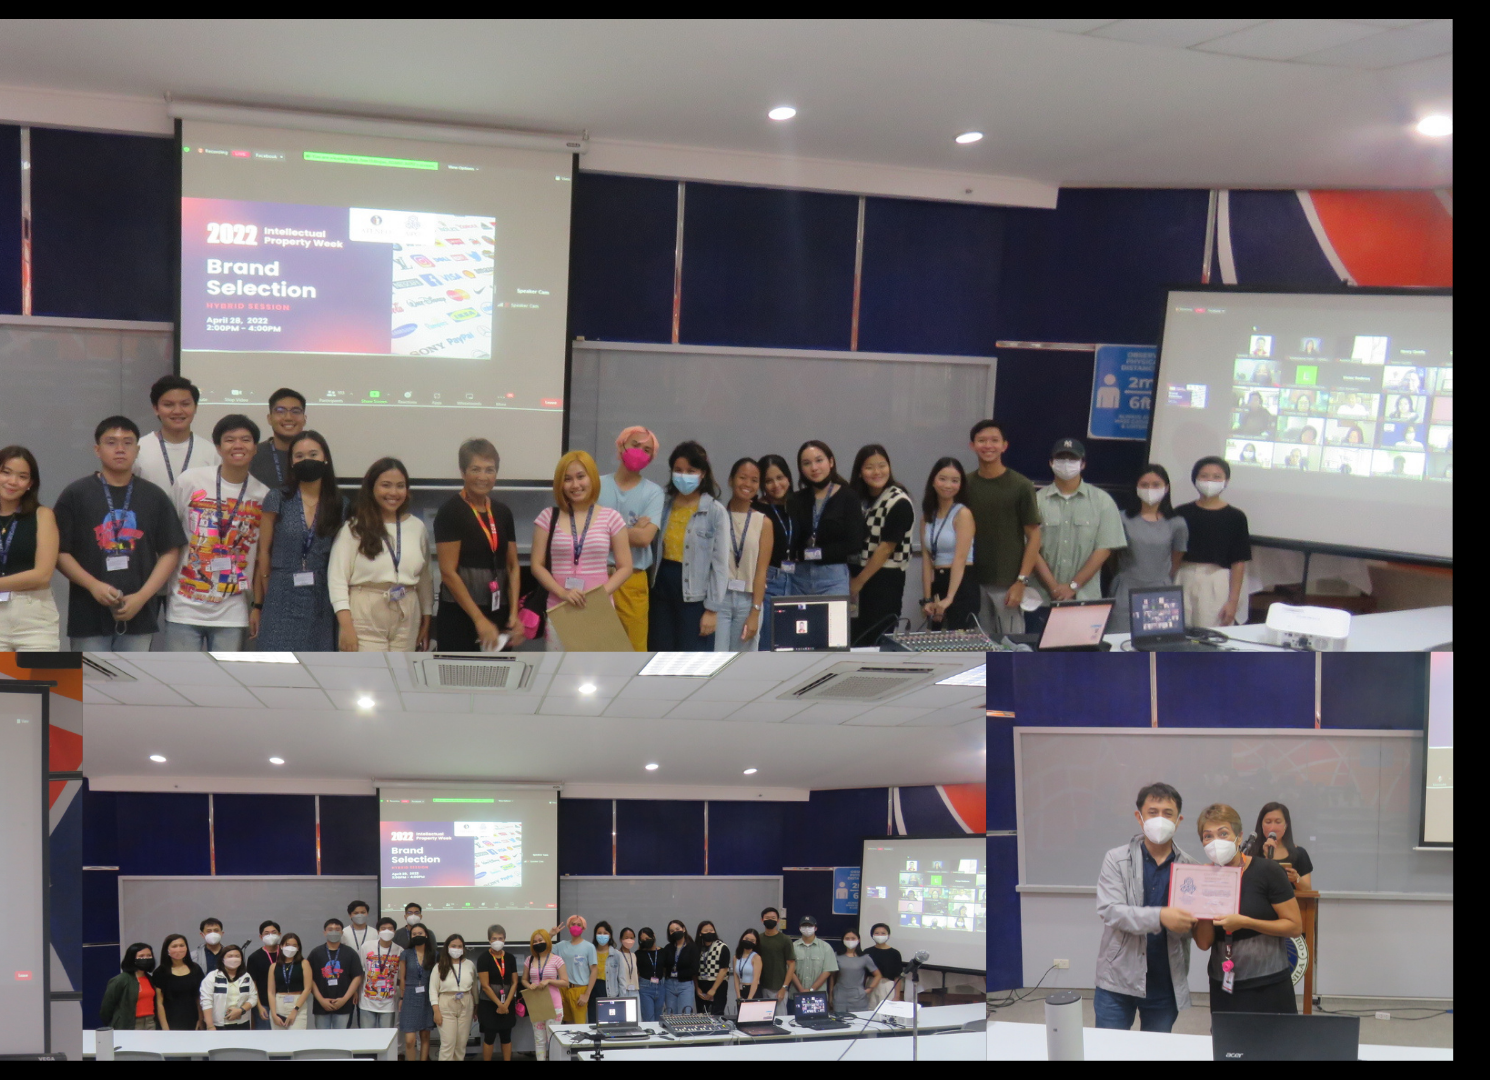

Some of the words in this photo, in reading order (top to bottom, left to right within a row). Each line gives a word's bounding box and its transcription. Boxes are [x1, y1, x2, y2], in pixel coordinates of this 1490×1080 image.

[207, 222, 258, 246] 2022
[264, 227, 326, 238] Intellectual
[264, 236, 311, 248] Property
[313, 239, 344, 248] Week
[207, 259, 279, 276] Brand
[207, 279, 317, 298] Selection
[206, 302, 245, 310] HYBRID
[248, 303, 290, 311] SESSION
[206, 317, 228, 325] April
[229, 317, 243, 325] 28,
[206, 324, 239, 332] 2:00PM
[446, 332, 475, 345] PayPal
[391, 831, 414, 842] 2022
[391, 847, 424, 855] Brand
[391, 855, 441, 864] Selection
